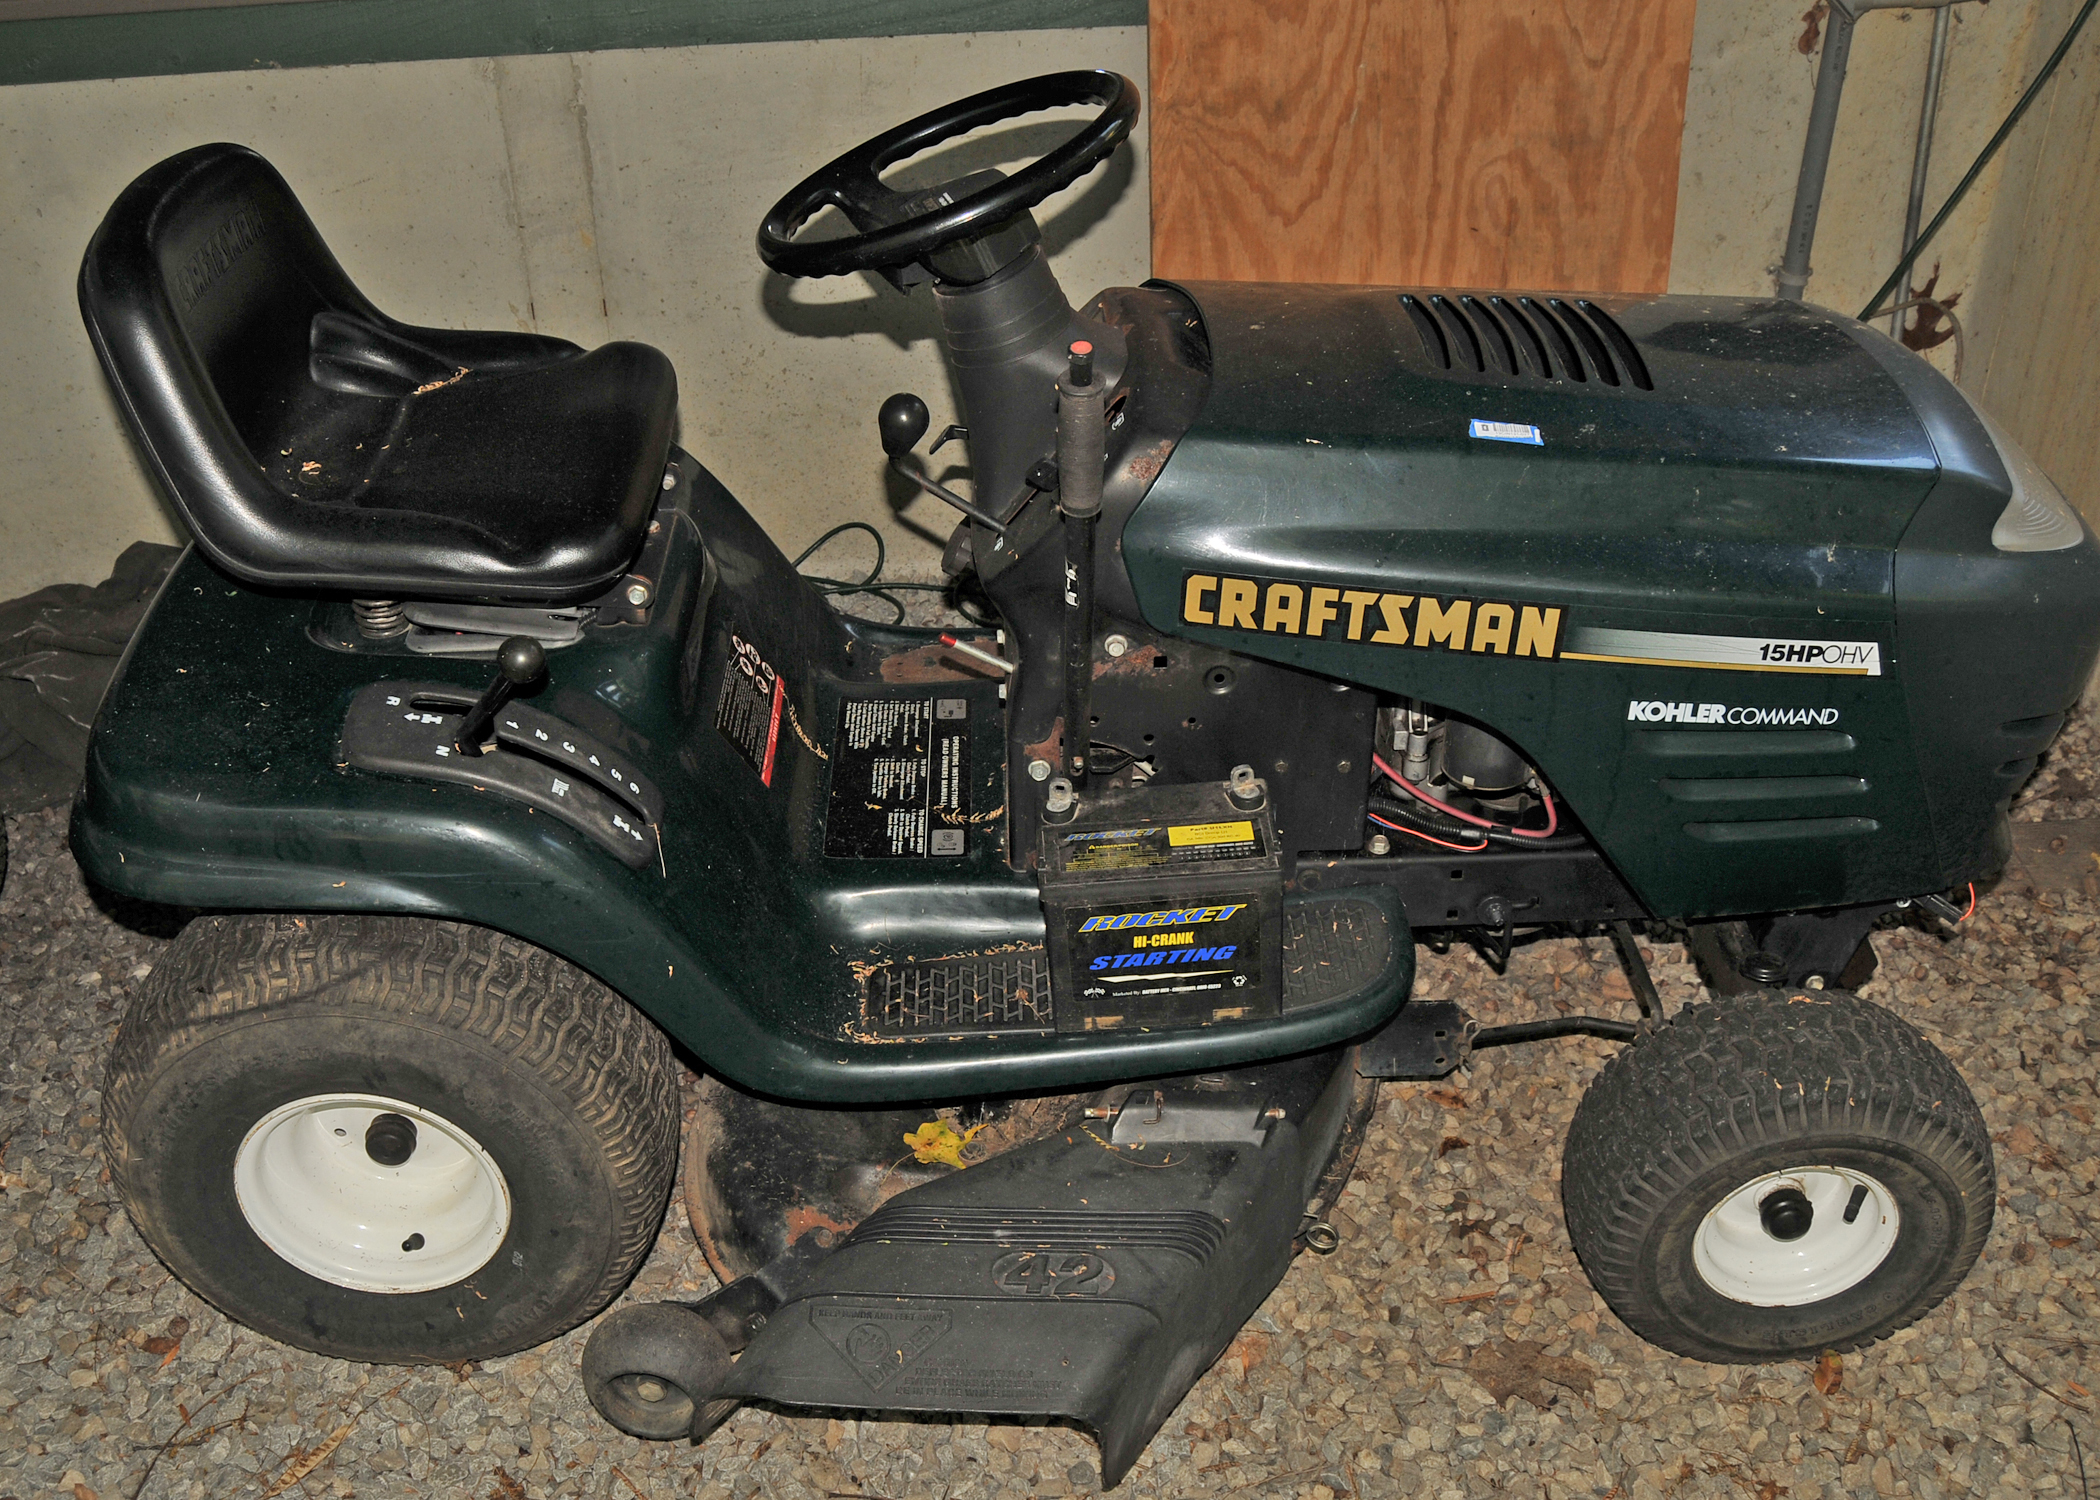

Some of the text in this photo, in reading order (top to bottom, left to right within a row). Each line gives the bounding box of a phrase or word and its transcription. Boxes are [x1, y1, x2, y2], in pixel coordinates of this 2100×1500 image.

[1184, 574, 1561, 658] CRAFTSMAN
[386, 696, 401, 706] R
[1627, 700, 1839, 725] KOHLER COMMAND
[506, 720, 519, 729] 1
[535, 729, 548, 741] 2
[435, 745, 450, 757] N
[562, 741, 575, 753] 3
[589, 755, 600, 766] 4
[611, 768, 622, 781] 5
[939, 738, 950, 805] (READ OWNERS MANUAL)
[951, 736, 960, 808] OPERATING INSTRUCTIONS
[629, 782, 640, 794] 6
[917, 816, 925, 836] CHANGE
[1063, 827, 1162, 841] ROCKET
[1078, 903, 1248, 933] ROCKET
[1133, 931, 1194, 948] HI-CRANK
[1089, 945, 1237, 970] STARTING
[1004, 1254, 1104, 1295] 42
[868, 1324, 936, 1384] DANGER
